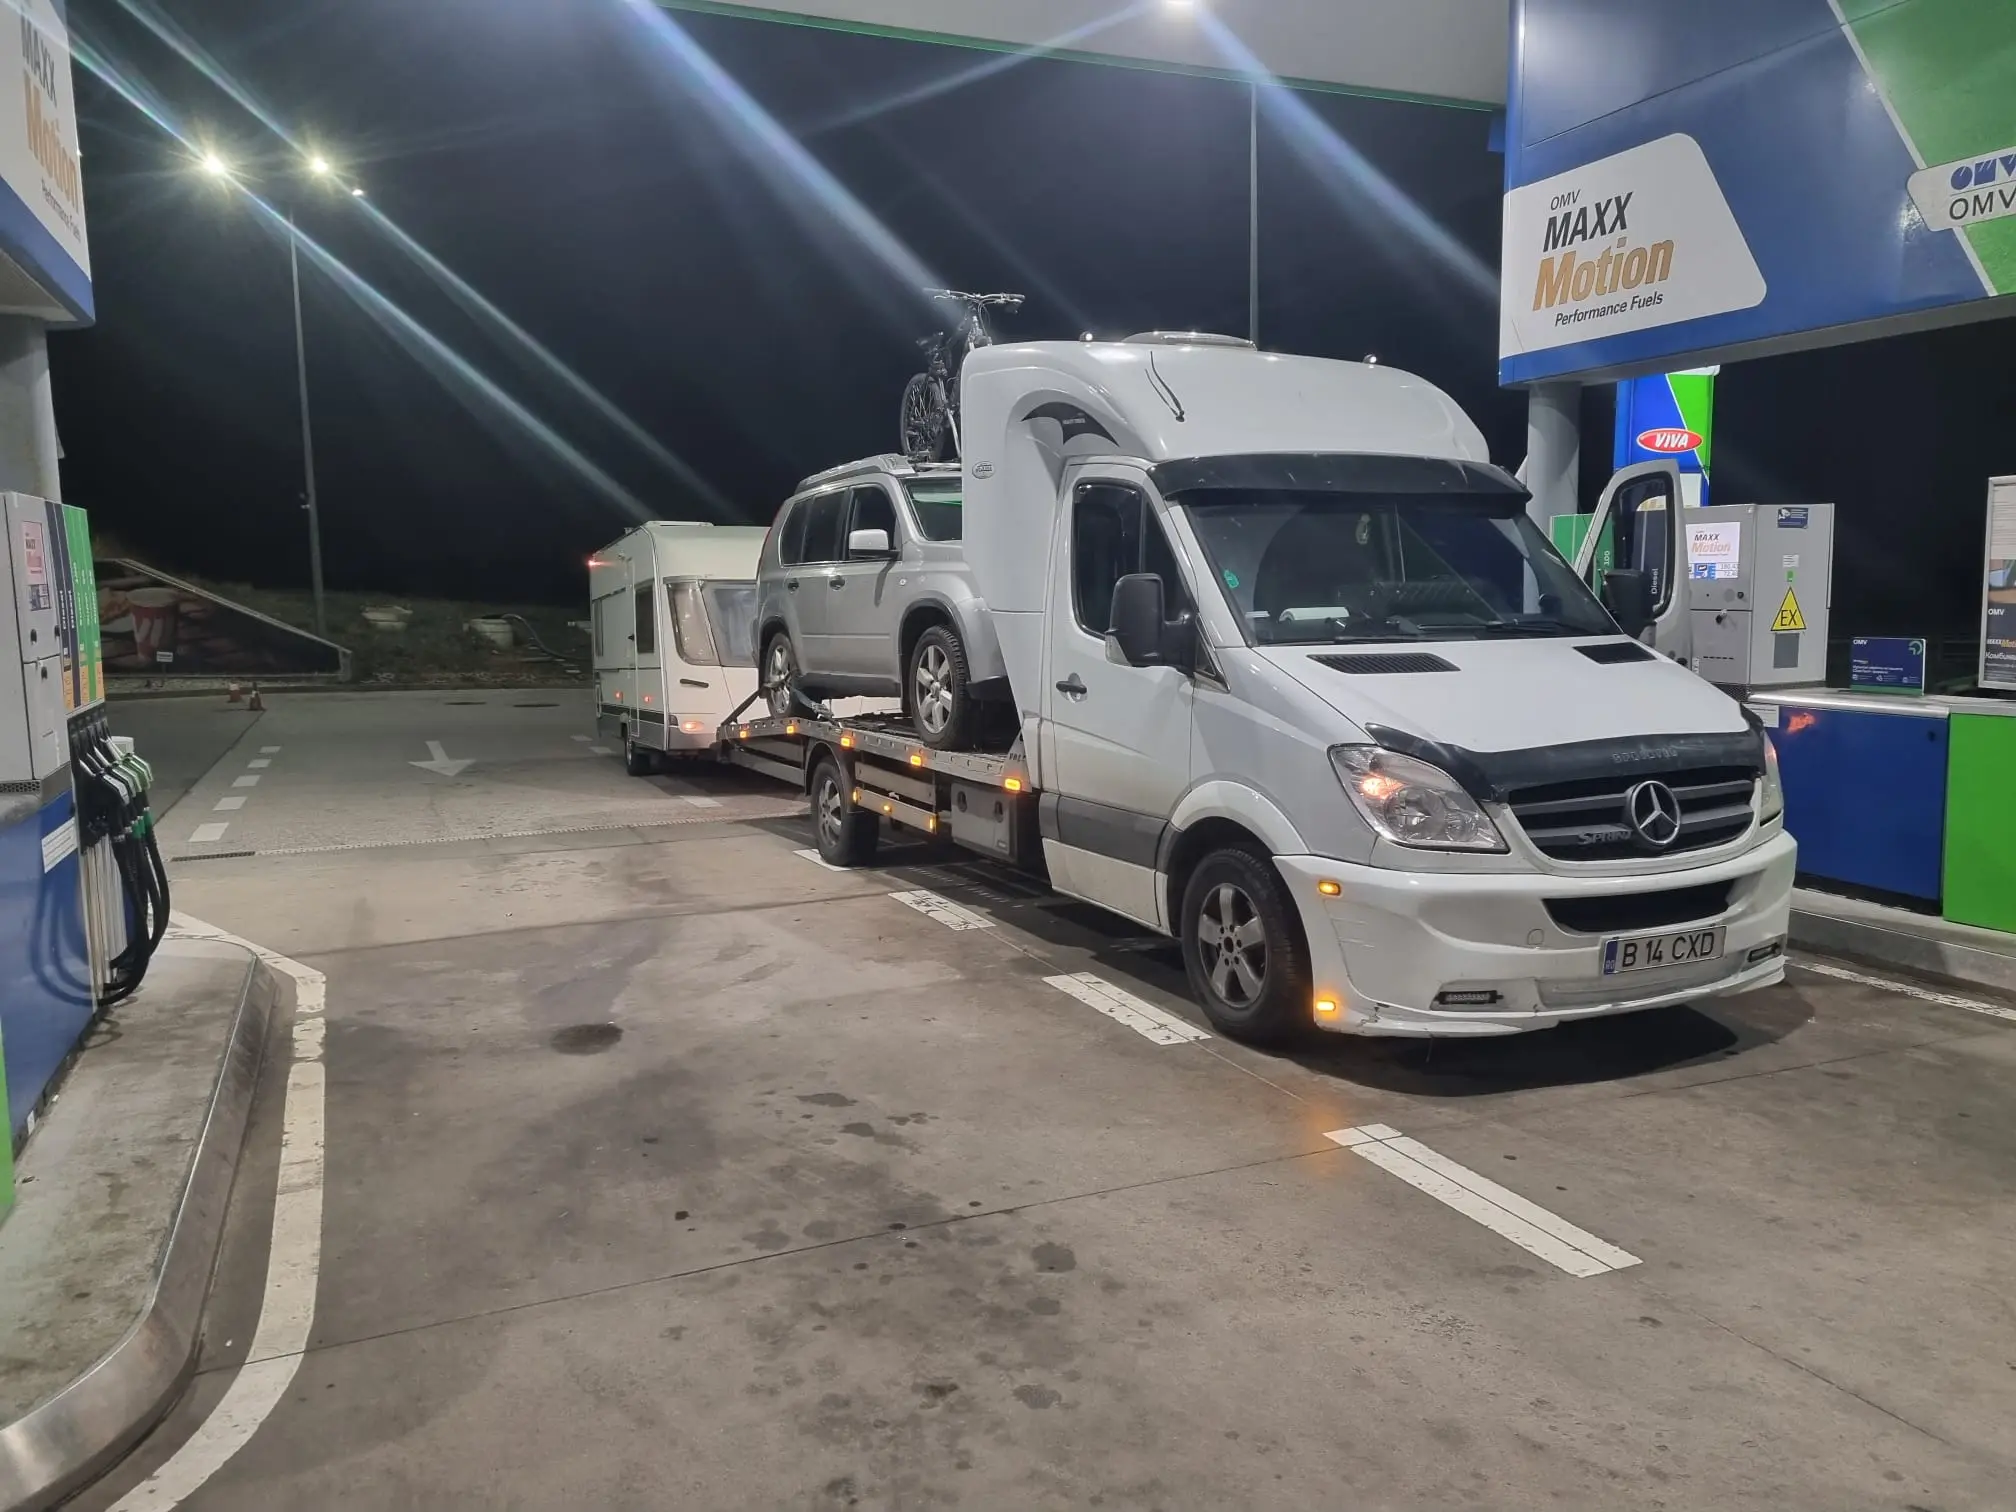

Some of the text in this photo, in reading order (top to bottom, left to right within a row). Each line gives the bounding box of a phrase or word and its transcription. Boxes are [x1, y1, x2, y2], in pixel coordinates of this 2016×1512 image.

[1550, 189, 1581, 211] OMV
[1949, 187, 2016, 220] OMV
[1543, 192, 1633, 252] MAXX
[1532, 236, 1675, 311] Motion
[1555, 291, 1664, 327] Performance Fuels
[1655, 433, 1689, 449] VIVA
[1692, 541, 1731, 553] Motion
[1694, 533, 1720, 541] MAXX
[1651, 568, 1659, 594] Diesel
[1779, 609, 1798, 627] EX
[1987, 608, 2005, 616] OMV
[1622, 931, 1715, 968] B 14 CXD
